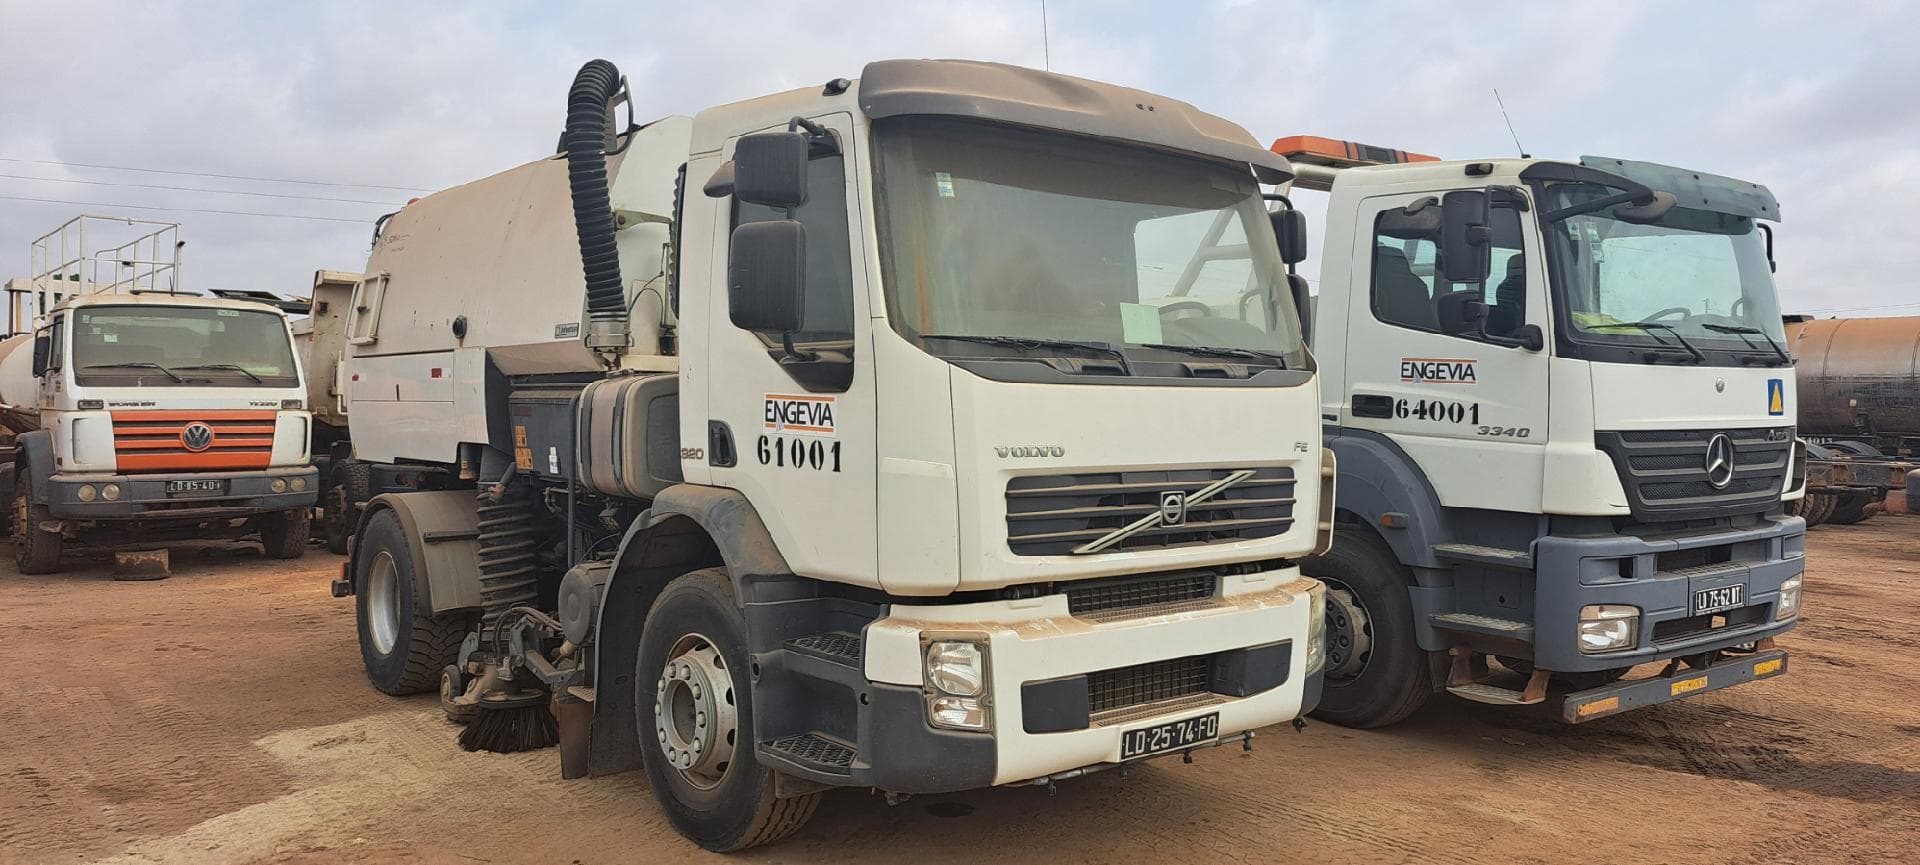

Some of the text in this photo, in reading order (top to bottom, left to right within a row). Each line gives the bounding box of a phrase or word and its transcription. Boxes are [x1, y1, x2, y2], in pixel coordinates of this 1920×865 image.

[1401, 361, 1476, 381] ENGEVIA
[765, 400, 834, 427] ENGEVIA
[1395, 398, 1479, 425] 64001
[1477, 425, 1530, 438] 3340
[757, 435, 841, 472] 61001
[993, 446, 1065, 459] VOLVO
